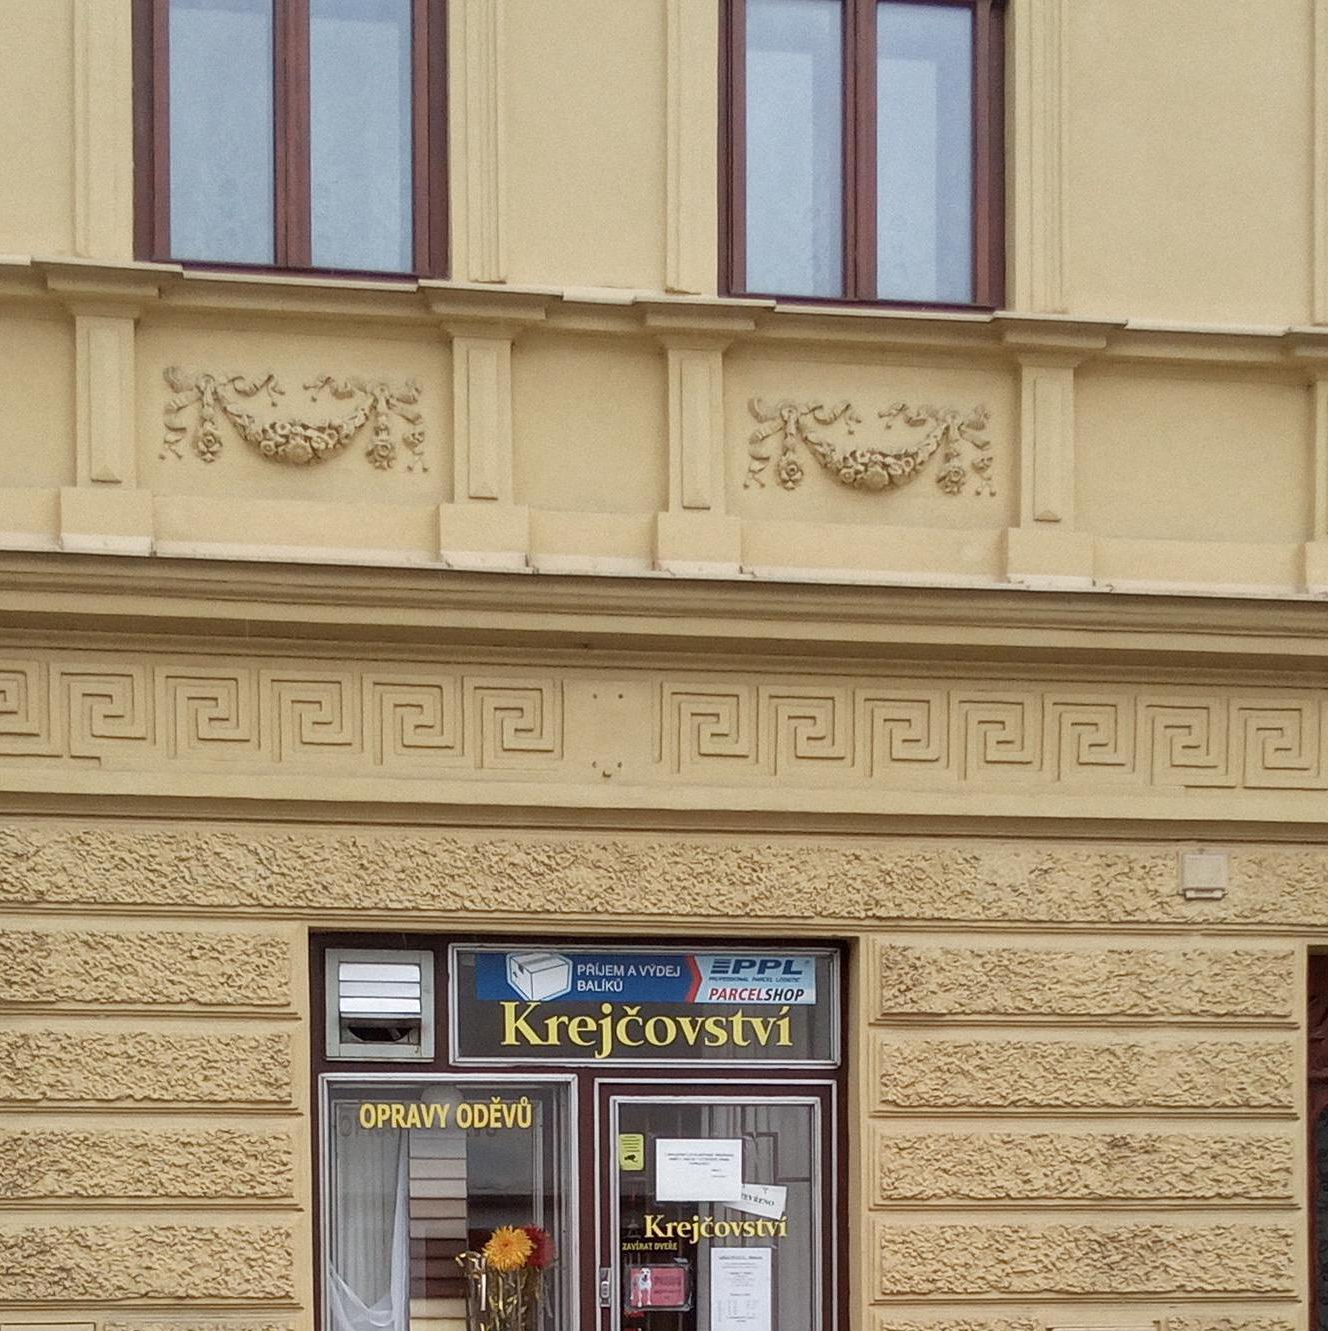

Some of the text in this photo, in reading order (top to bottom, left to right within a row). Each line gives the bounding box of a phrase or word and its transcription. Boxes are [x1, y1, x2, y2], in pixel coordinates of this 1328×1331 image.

[577, 961, 681, 977] PŘÍJEM A VÝDEJ
[731, 958, 803, 976] PPL
[577, 979, 623, 993] BALÍKŮ
[709, 988, 805, 1002] PARCELSHOP
[500, 1001, 793, 1059] Krejčovství
[359, 1096, 532, 1129] OPRAVY ODĚVŮ
[644, 1214, 788, 1244] Krejčovství
